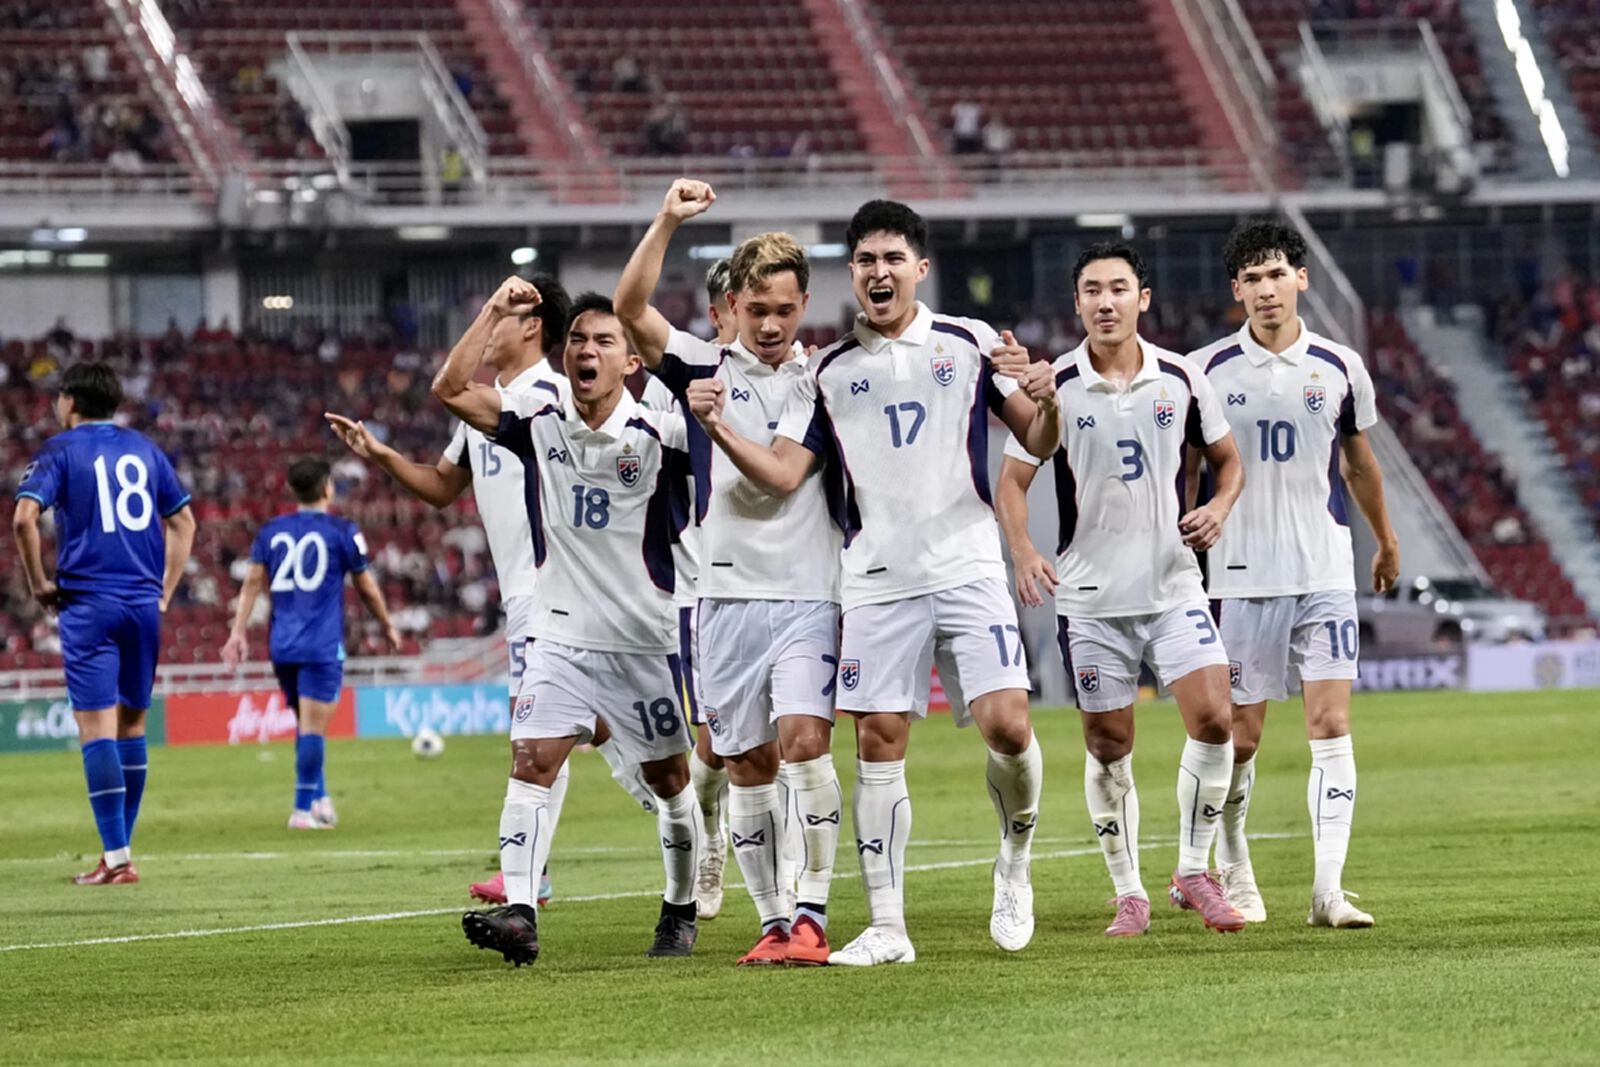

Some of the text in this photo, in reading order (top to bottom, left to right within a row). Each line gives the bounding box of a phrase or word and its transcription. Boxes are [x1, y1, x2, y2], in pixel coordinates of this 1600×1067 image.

[883, 401, 926, 448] 17
[1257, 419, 1296, 462] 10
[478, 442, 502, 478] 15
[1116, 439, 1143, 482] 3
[93, 454, 153, 532] 18
[571, 485, 611, 530] 18
[270, 531, 329, 592] 20
[988, 624, 1023, 668] 17
[1185, 609, 1218, 645] 3
[1323, 619, 1357, 661] 10
[508, 641, 527, 678] 5
[632, 696, 681, 742] 18
